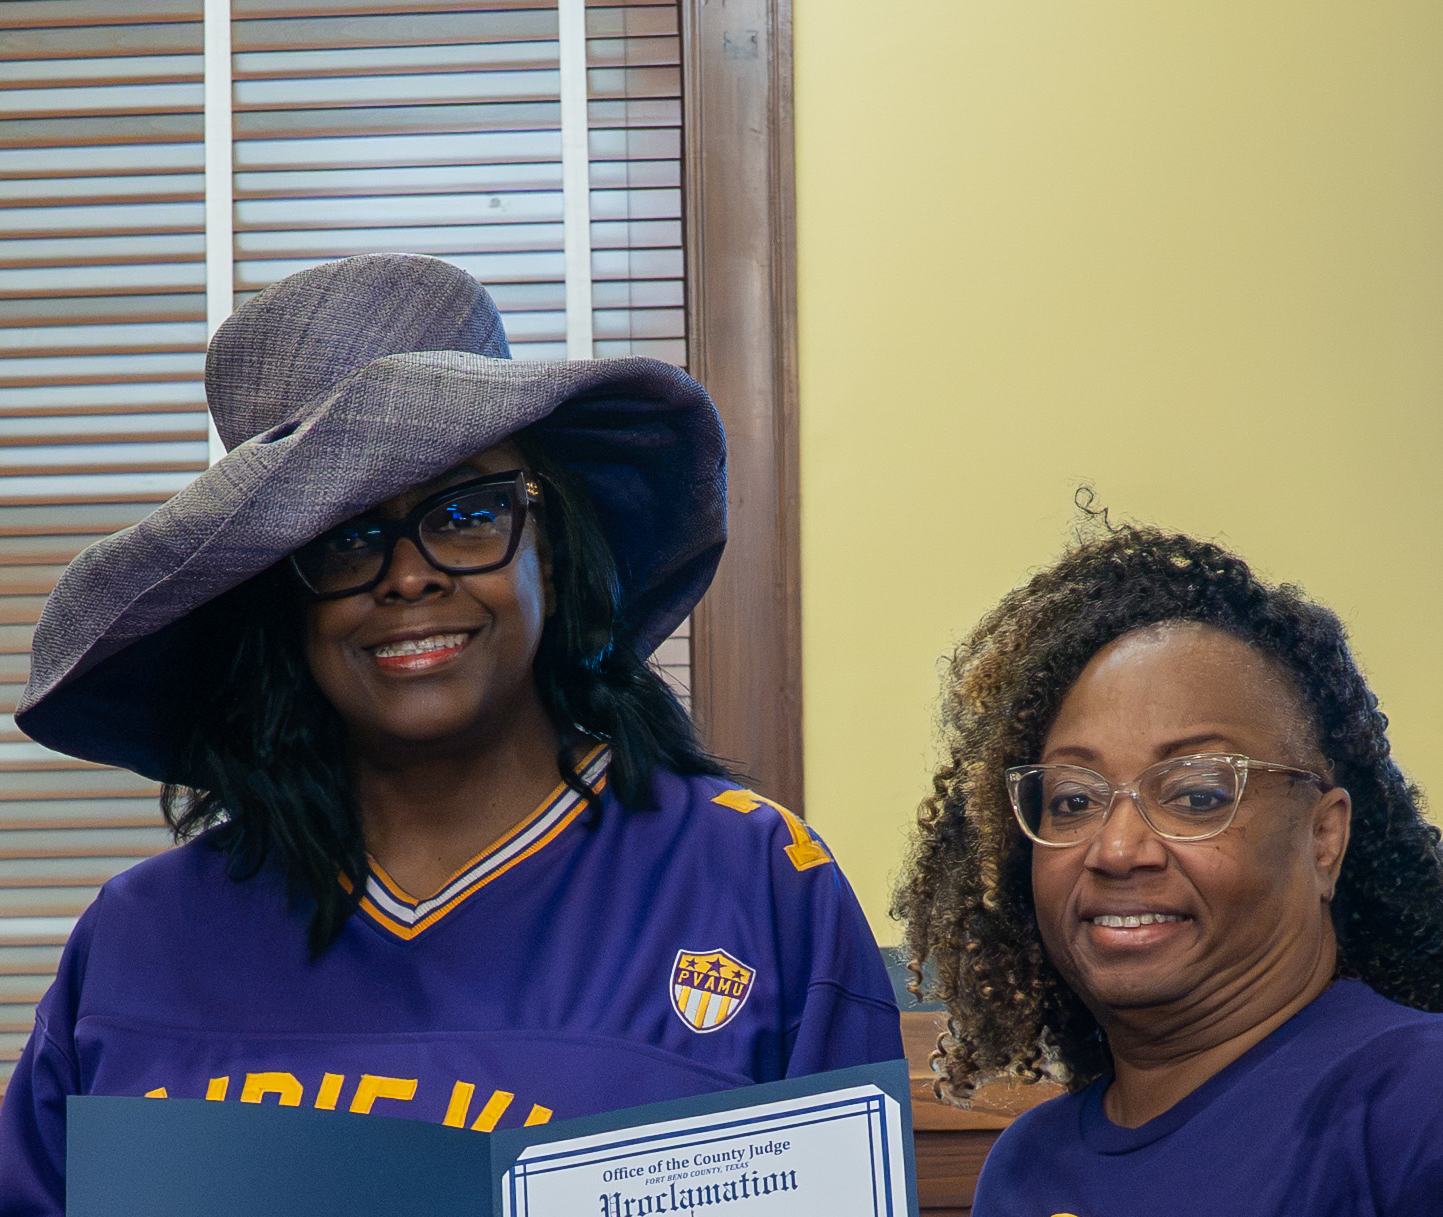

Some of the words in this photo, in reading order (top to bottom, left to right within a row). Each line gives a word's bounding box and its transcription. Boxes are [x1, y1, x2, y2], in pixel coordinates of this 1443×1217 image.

[677, 970, 745, 997] PVAMU
[603, 1167, 644, 1182] Office
[648, 1159, 663, 1174] of
[666, 1158, 689, 1170] the
[693, 1149, 745, 1165] County
[749, 1140, 790, 1159] Judge
